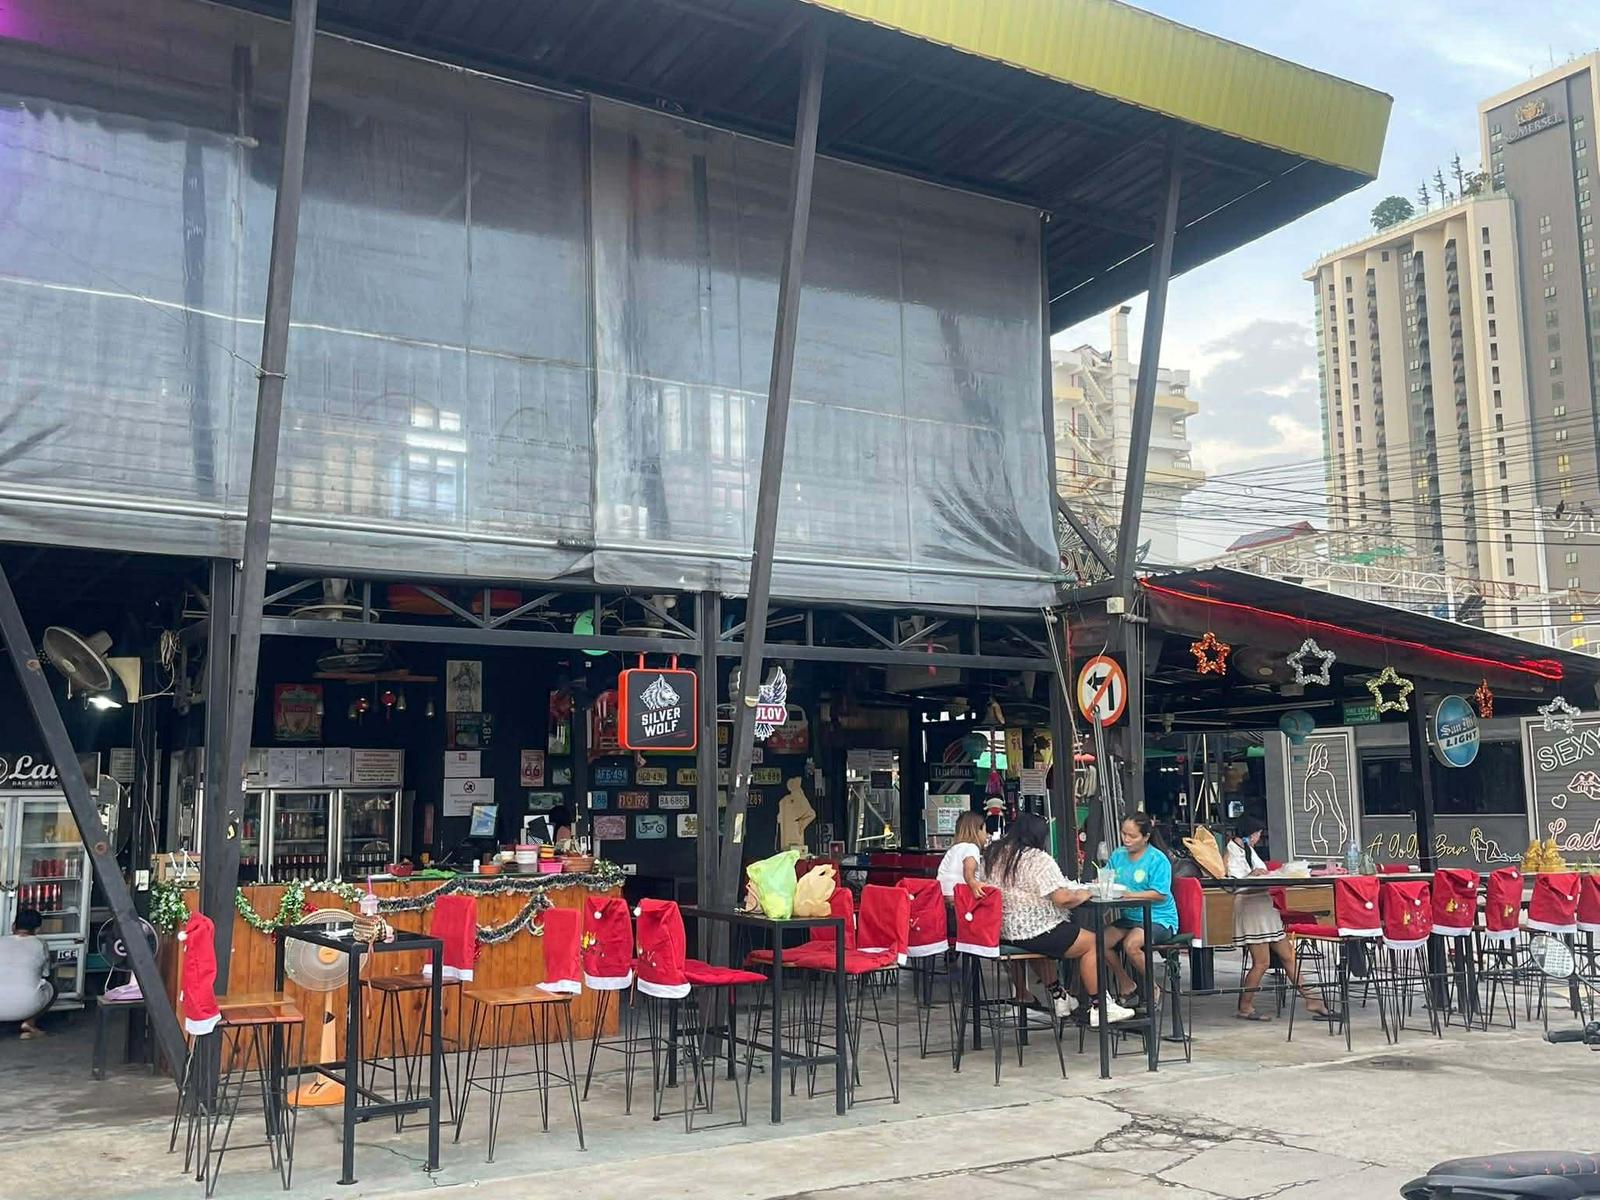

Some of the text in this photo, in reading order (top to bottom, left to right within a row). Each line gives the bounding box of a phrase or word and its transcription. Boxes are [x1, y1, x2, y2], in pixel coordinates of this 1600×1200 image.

[641, 707, 681, 726] SILVER
[645, 720, 679, 738] WOLF
[1446, 730, 1477, 747] LIGHT
[1367, 832, 1384, 858] A
[1435, 833, 1468, 859] Bar
[57, 949, 79, 960] ICE
